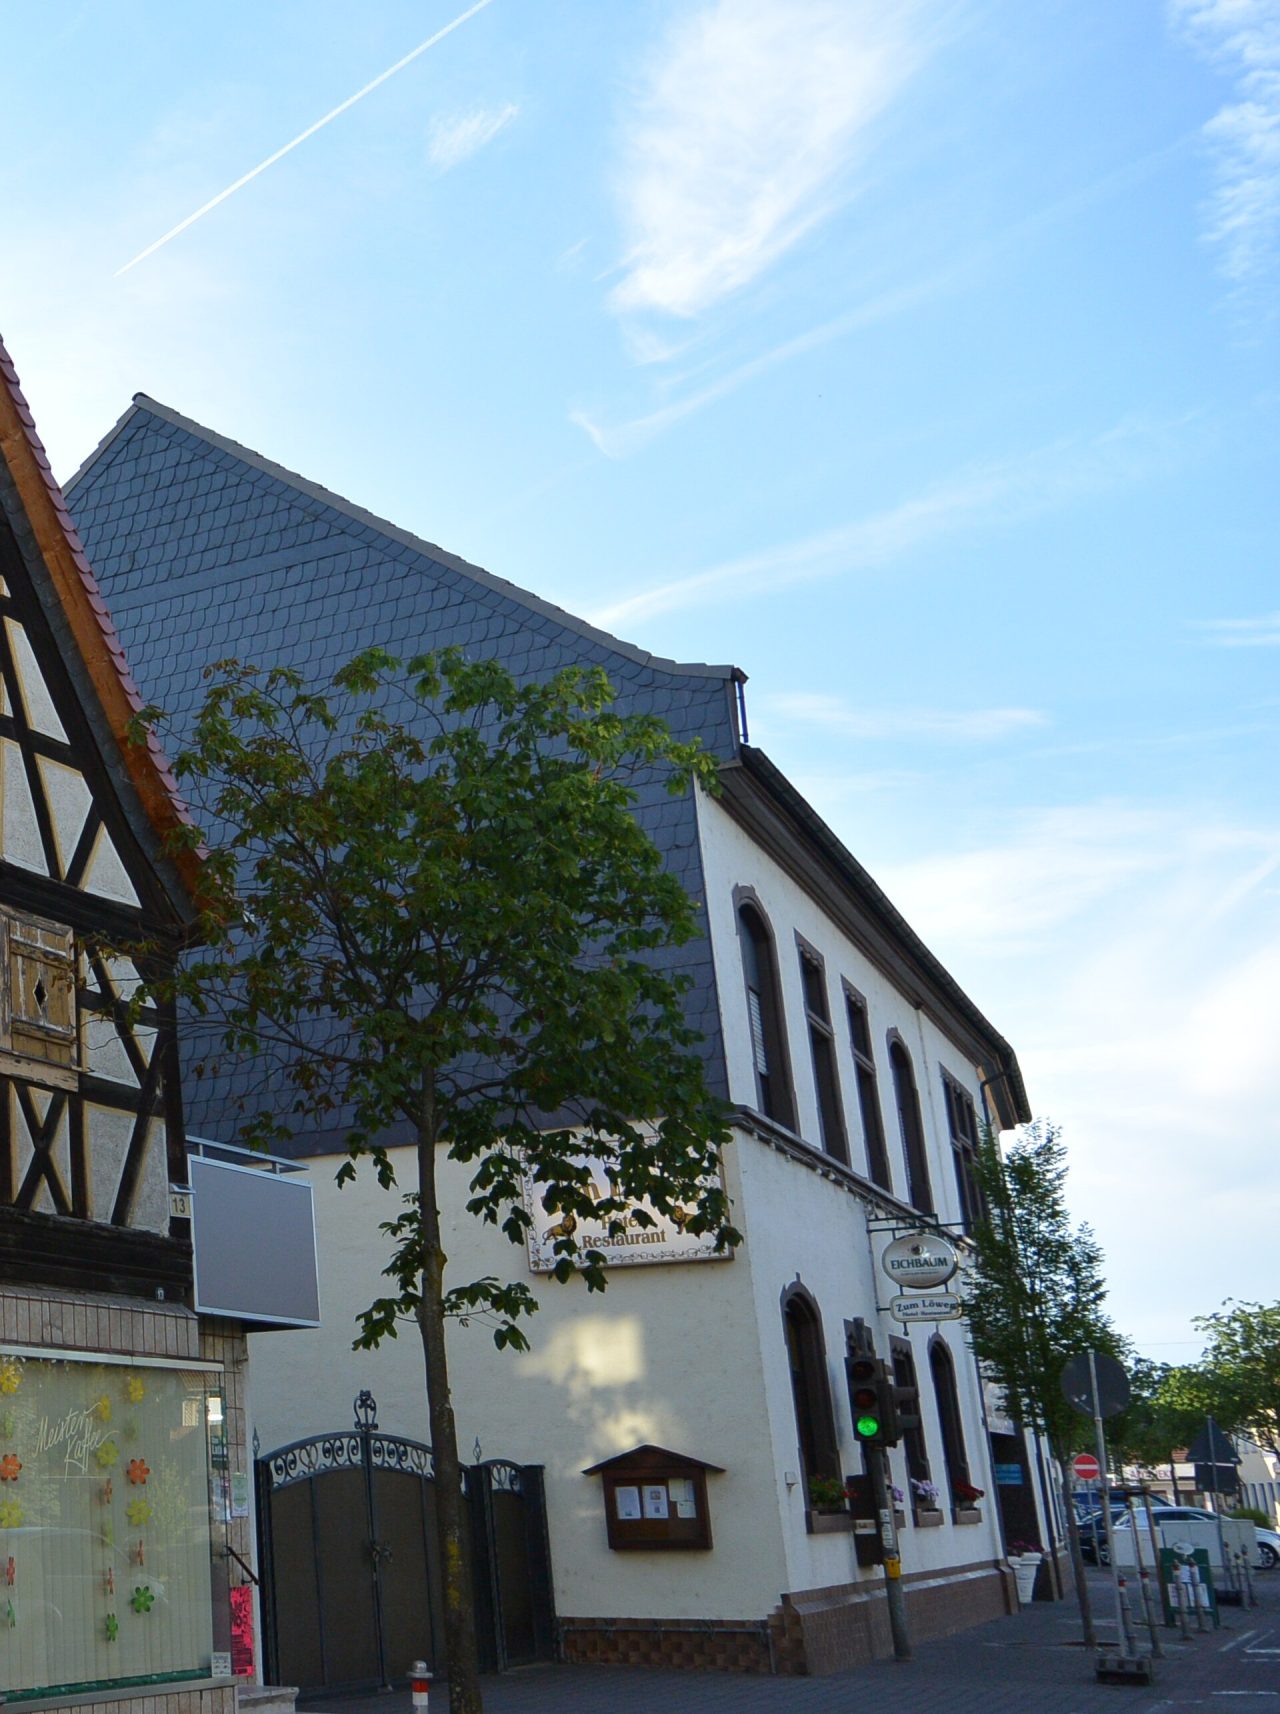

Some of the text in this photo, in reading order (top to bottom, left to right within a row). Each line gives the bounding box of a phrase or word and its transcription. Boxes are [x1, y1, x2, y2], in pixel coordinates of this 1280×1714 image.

[173, 1197, 186, 1214] 13
[601, 1213, 642, 1231] Hte
[582, 1230, 667, 1249] Restaurant
[890, 1257, 948, 1270] EICHBAUM
[896, 1302, 919, 1313] Zum
[31, 1402, 103, 1458] Meister
[64, 1416, 120, 1483] Kaffee
